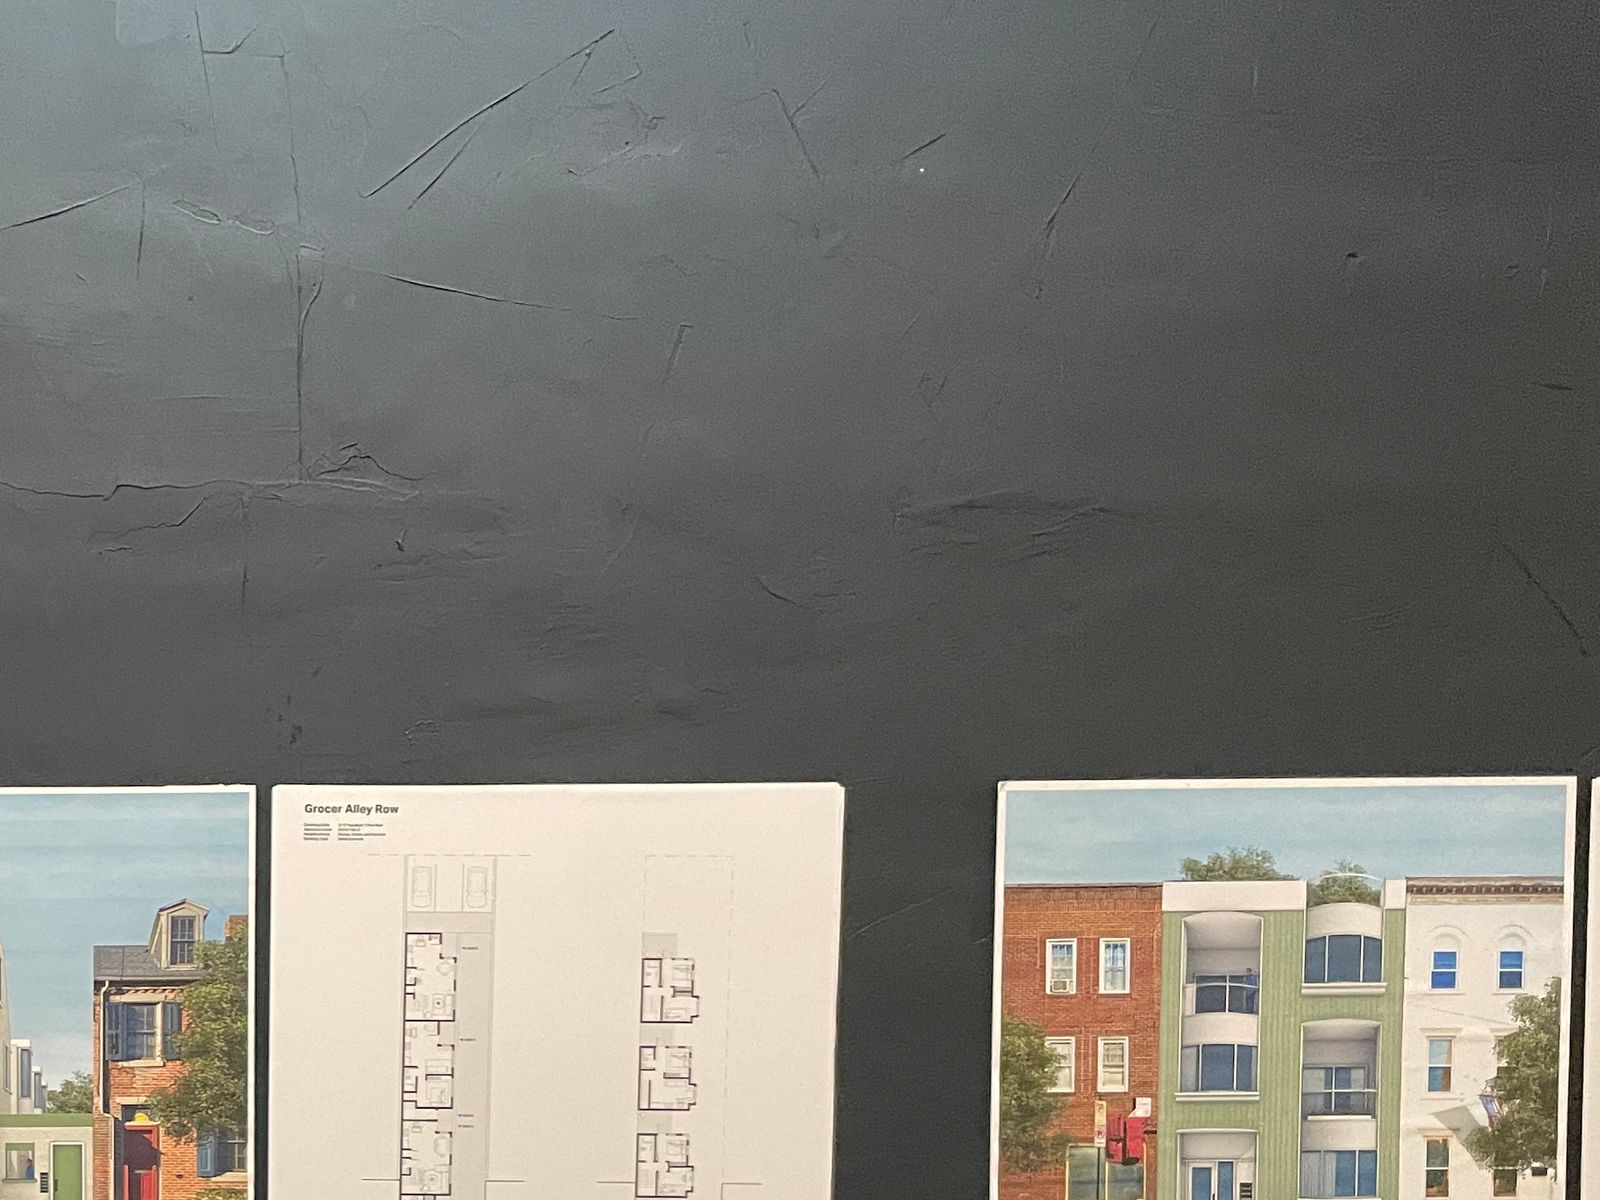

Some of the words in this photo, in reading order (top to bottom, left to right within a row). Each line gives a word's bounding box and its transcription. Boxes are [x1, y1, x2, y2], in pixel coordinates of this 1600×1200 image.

[304, 804, 342, 814] Grocer
[345, 804, 373, 816] Alley
[375, 804, 399, 814] Row
